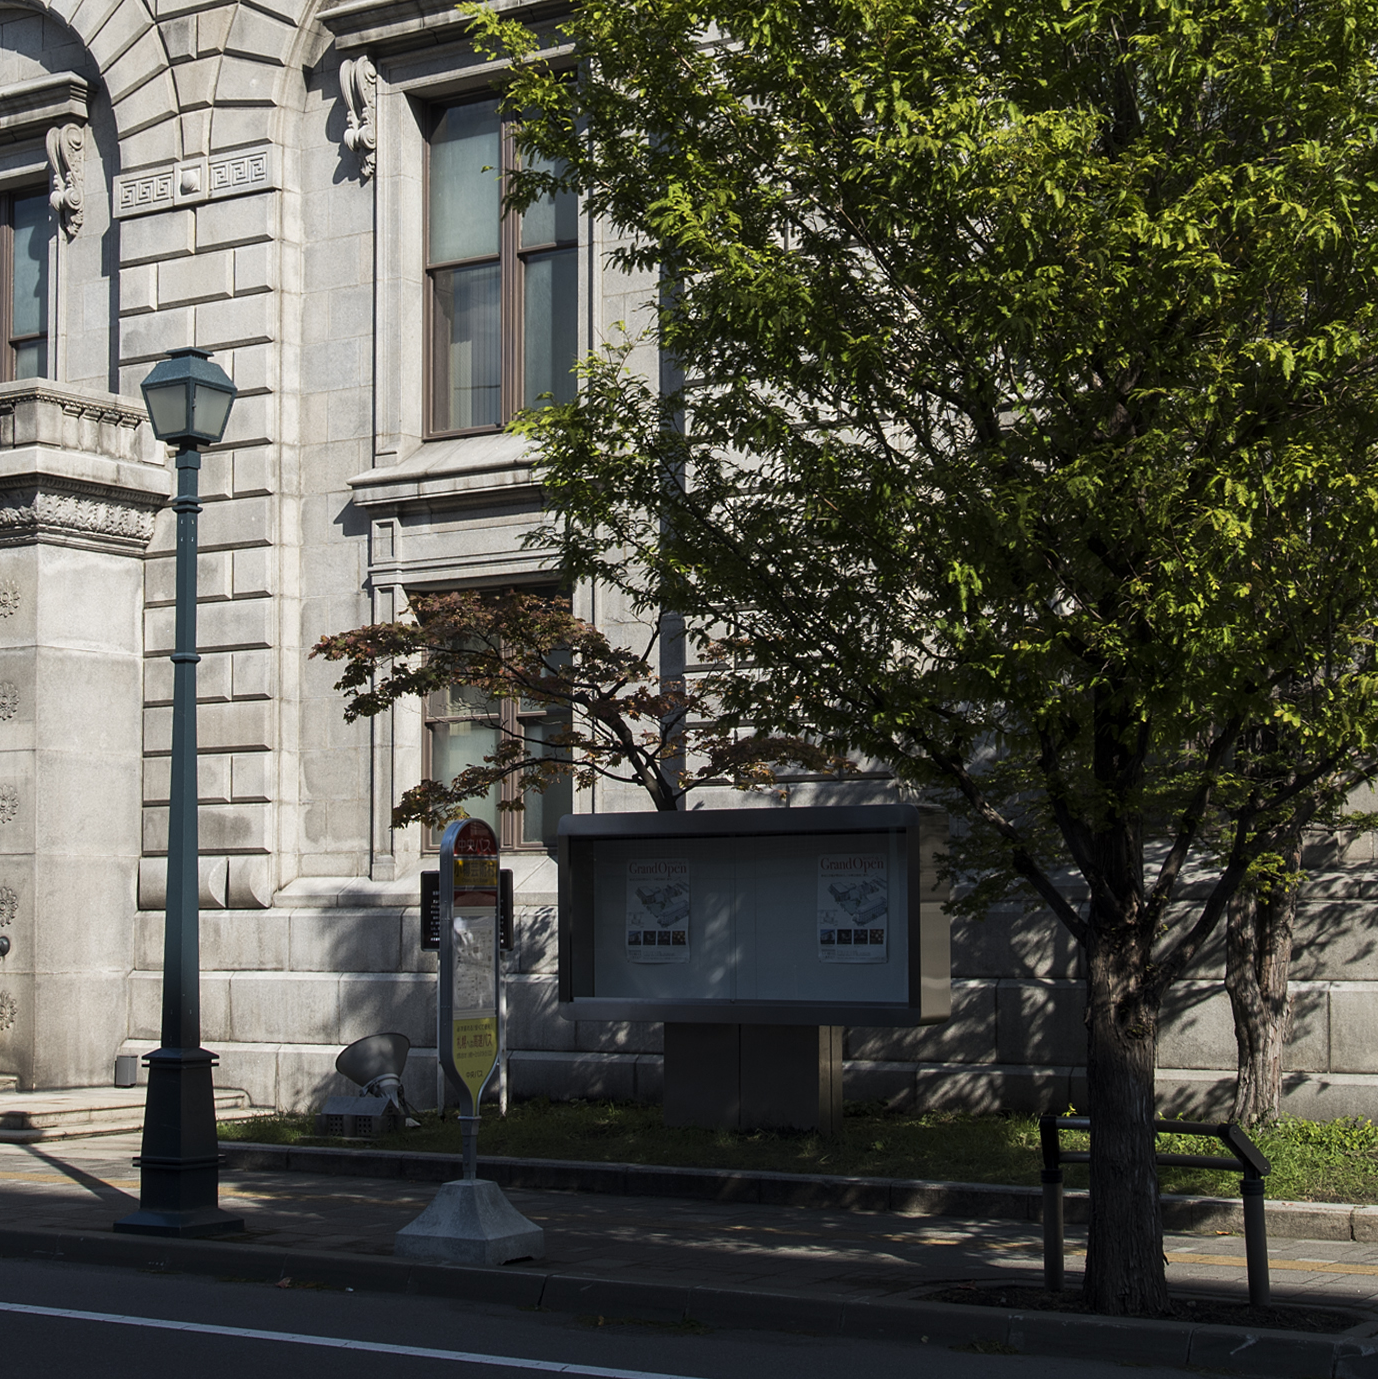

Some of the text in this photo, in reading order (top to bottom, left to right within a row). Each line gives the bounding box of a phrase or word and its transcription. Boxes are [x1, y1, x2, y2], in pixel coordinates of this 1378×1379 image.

[458, 838, 492, 852] 中央バス
[629, 861, 687, 877] Grand Open
[820, 857, 884, 873] Grand Open
